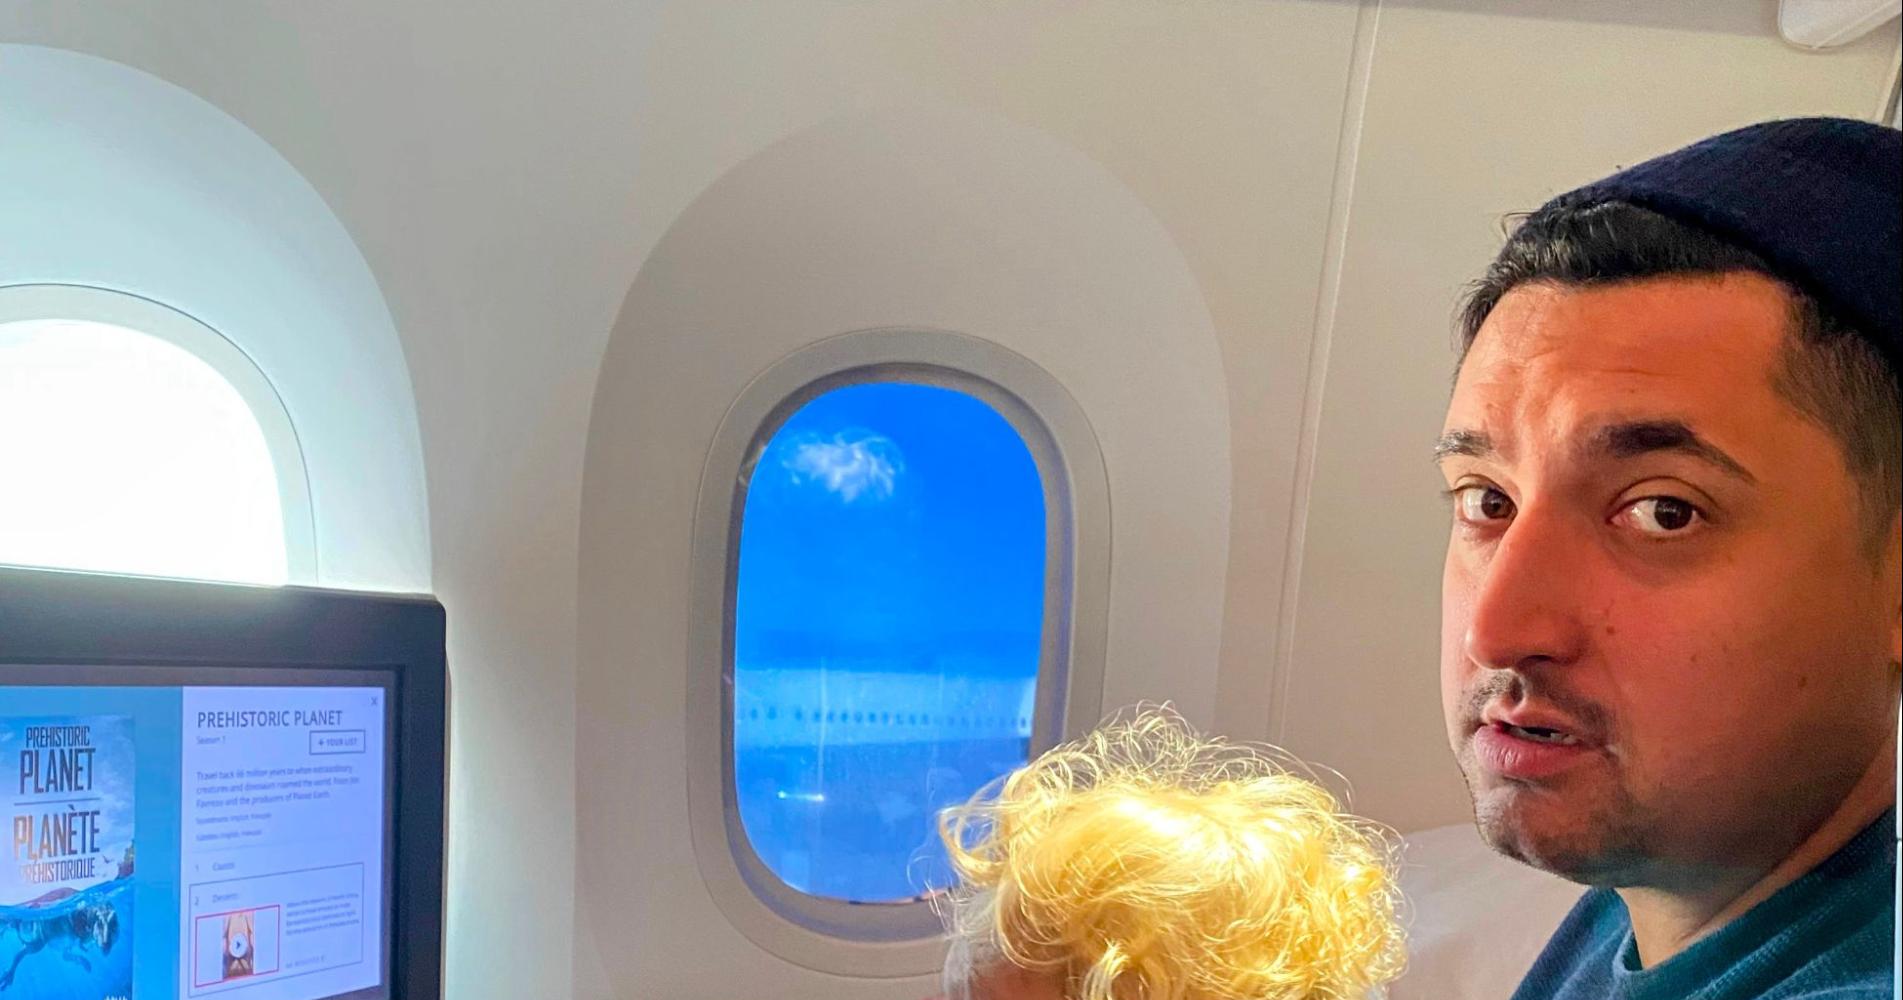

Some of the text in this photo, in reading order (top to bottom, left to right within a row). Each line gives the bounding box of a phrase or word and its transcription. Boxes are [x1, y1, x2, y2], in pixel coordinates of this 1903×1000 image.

[197, 709, 343, 728] PREHISTORIC PLANET
[25, 725, 90, 748] PREHISTORIC
[19, 748, 96, 795] PLANET
[14, 804, 100, 860] PLANÈTE
[20, 857, 95, 884] PRÉHISTORIQUE
